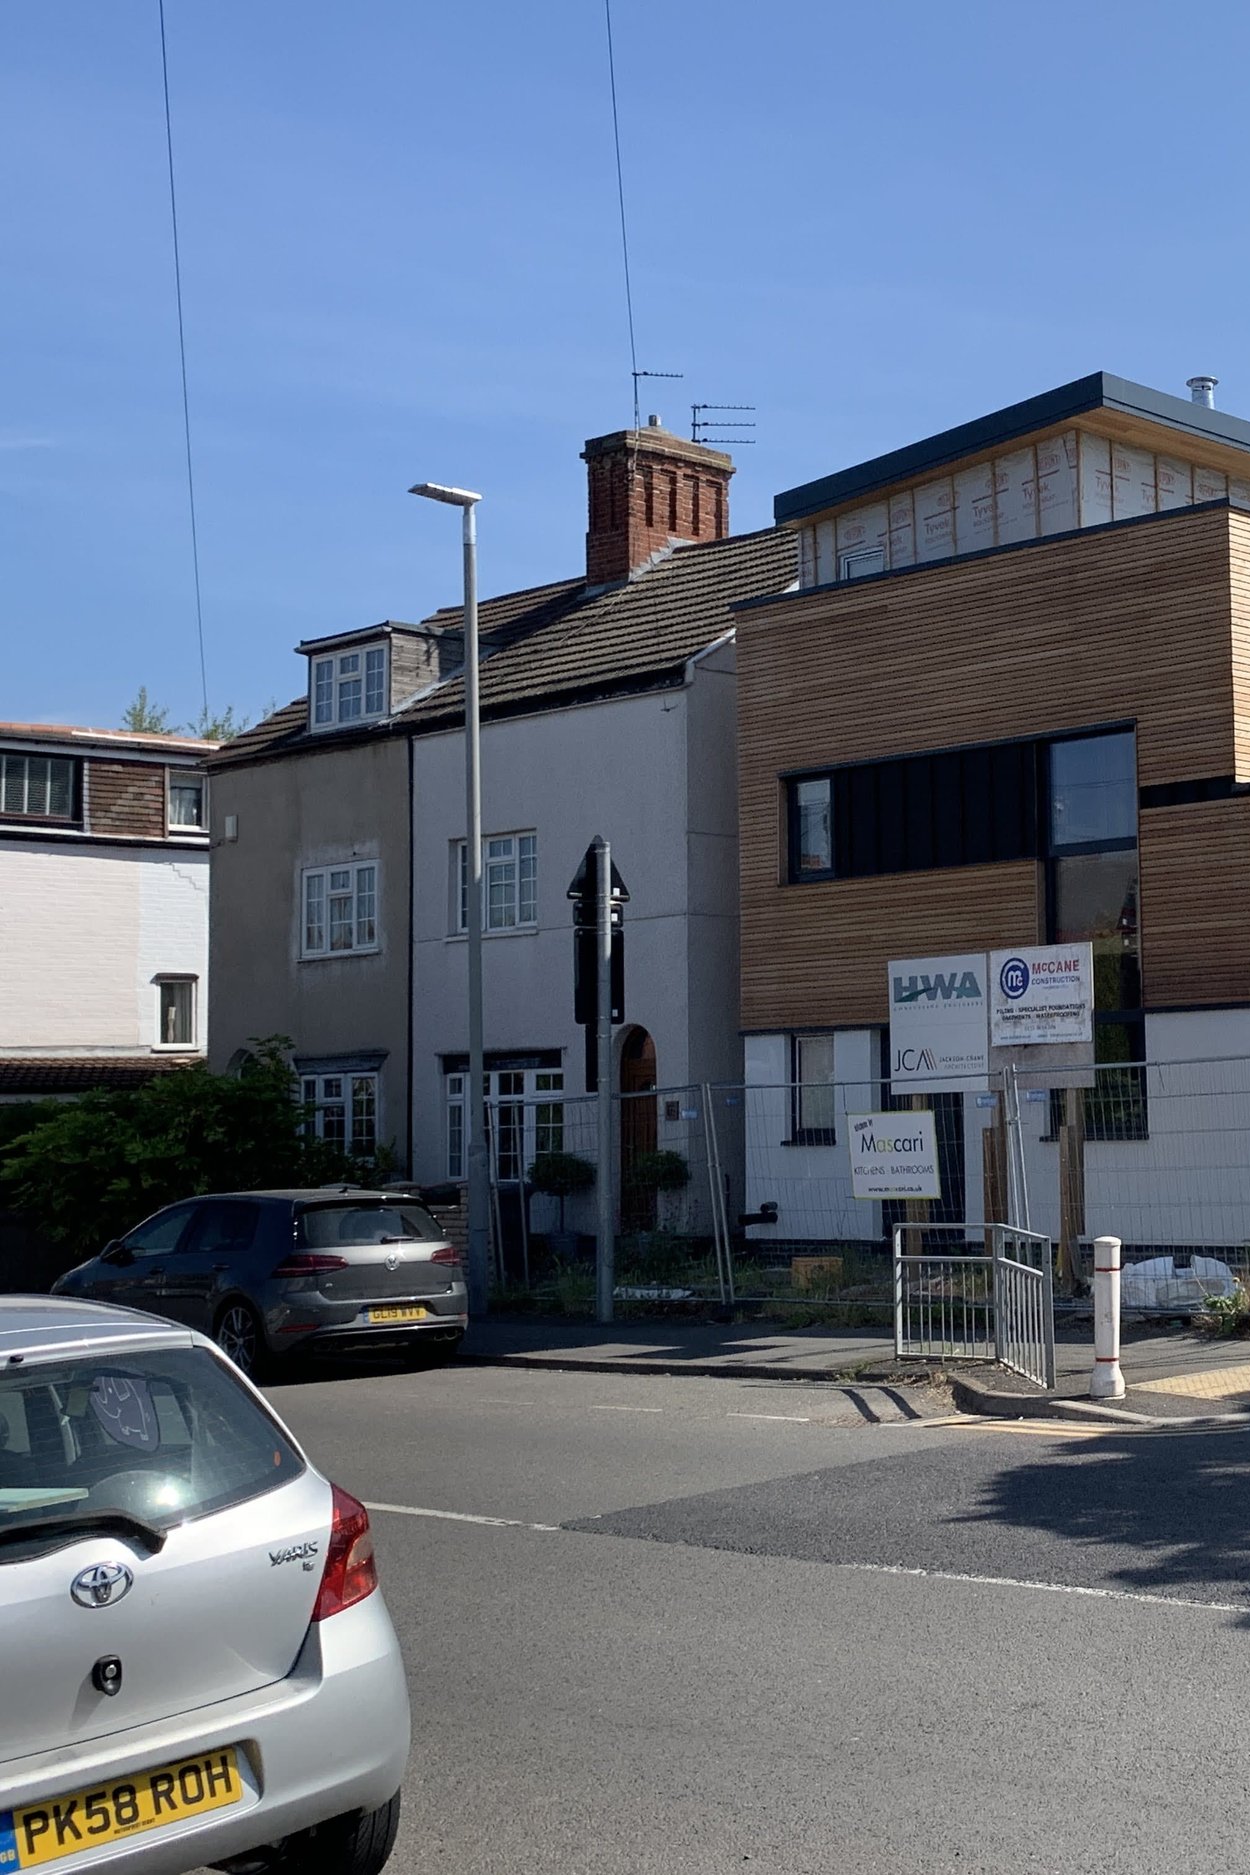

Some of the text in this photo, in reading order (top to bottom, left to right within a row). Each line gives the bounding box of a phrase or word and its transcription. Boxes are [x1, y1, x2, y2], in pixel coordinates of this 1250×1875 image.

[893, 971, 982, 1003] HWA
[1032, 976, 1080, 986] CONSTRUCTION
[1018, 1005, 1047, 1013] SPECIALIST
[1048, 1003, 1086, 1012] FOUNDATIONS
[894, 1048, 935, 1072] JCA
[861, 1130, 924, 1153] Mascari
[854, 1164, 934, 1176] KITCHENS BATHROOMS
[268, 1541, 318, 1567] YARIS
[22, 1755, 232, 1855] PK58 ROH
[0, 1849, 16, 1864] GB
